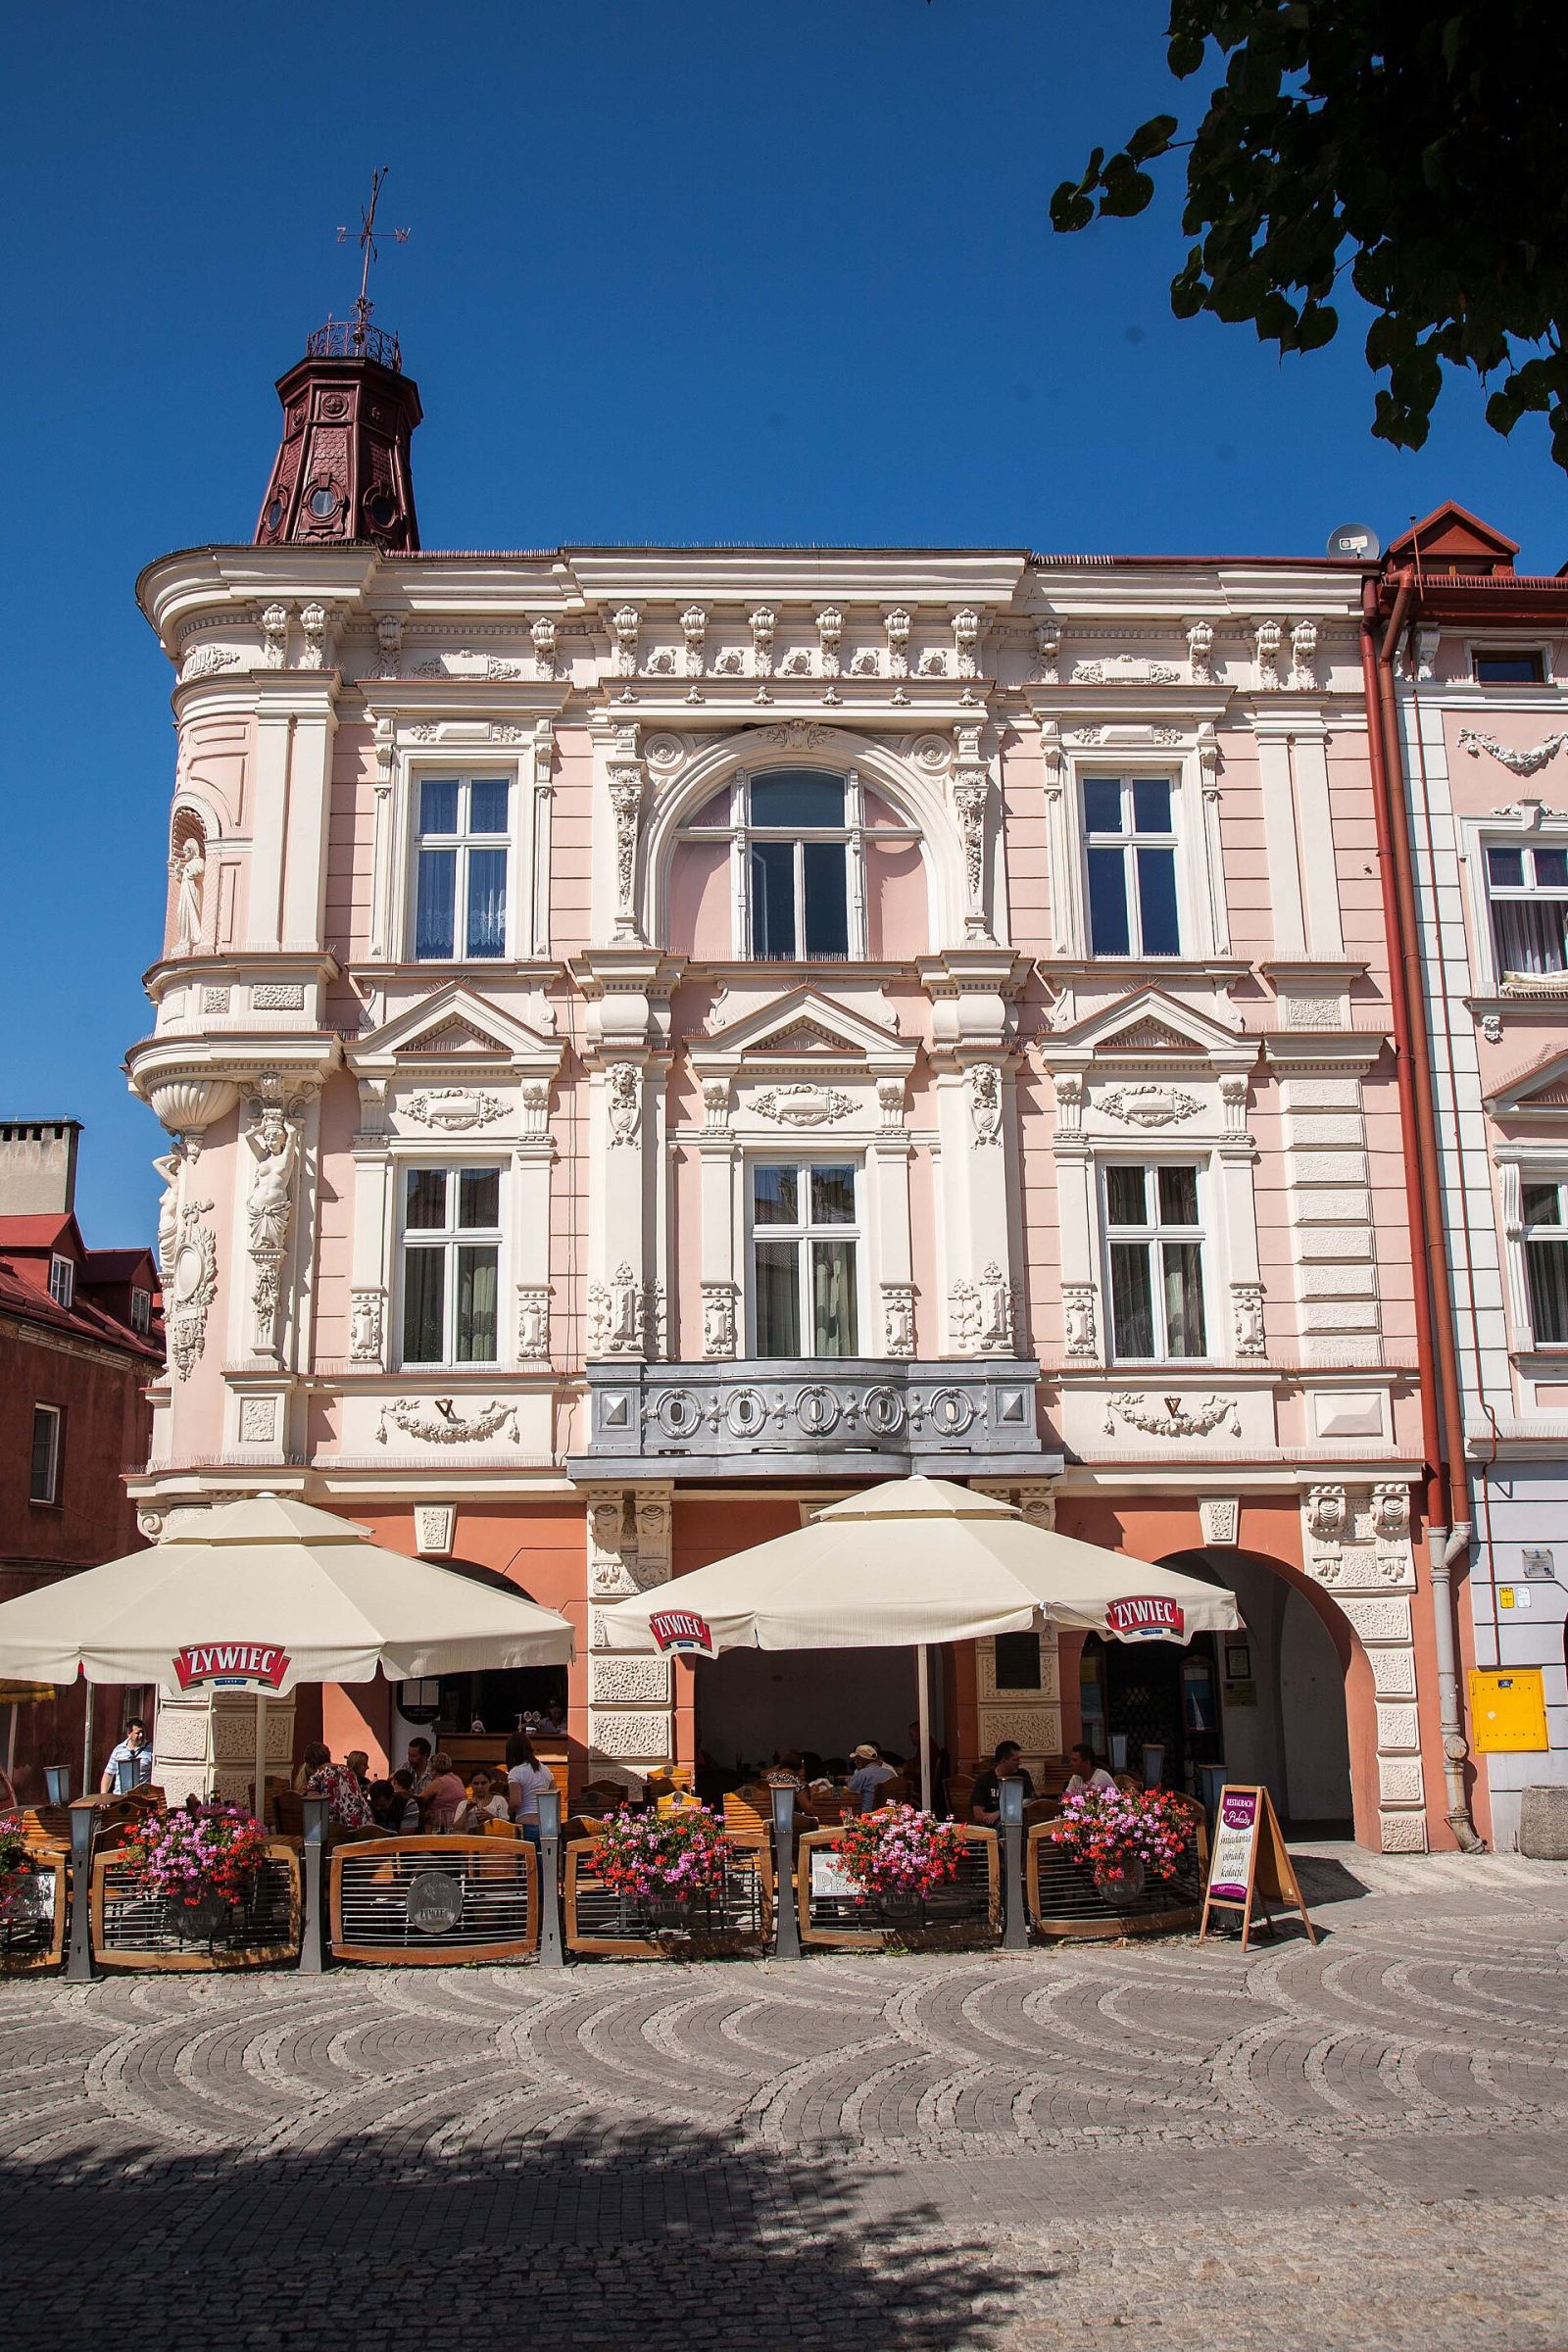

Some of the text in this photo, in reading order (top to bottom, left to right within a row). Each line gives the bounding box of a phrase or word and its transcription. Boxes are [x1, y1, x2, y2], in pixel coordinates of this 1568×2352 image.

[654, 1614, 703, 1639] ŻYWIEC
[1114, 1600, 1174, 1628] ŻYWIEC
[187, 1646, 275, 1674] ŻYWIEC
